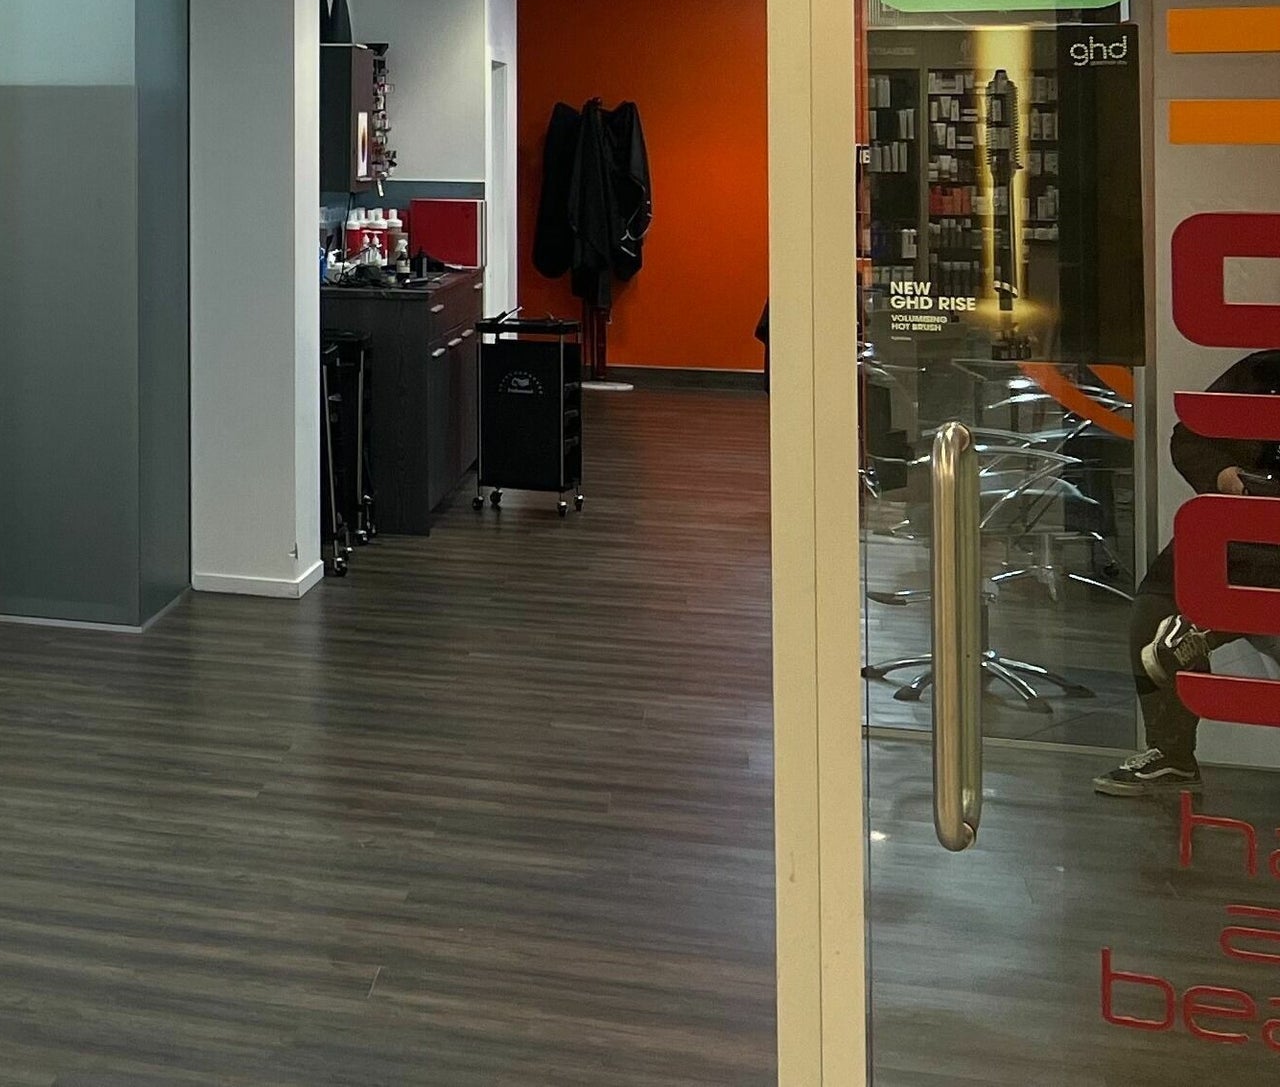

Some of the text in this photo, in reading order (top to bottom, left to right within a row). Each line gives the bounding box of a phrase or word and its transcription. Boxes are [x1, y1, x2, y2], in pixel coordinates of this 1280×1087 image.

[1070, 35, 1128, 66] ghd
[890, 281, 932, 296] NEW
[890, 295, 977, 311] GHD RISE
[891, 323, 942, 332] HOT BRUSH
[1179, 790, 1280, 879] h
[1100, 945, 1280, 1054] be
